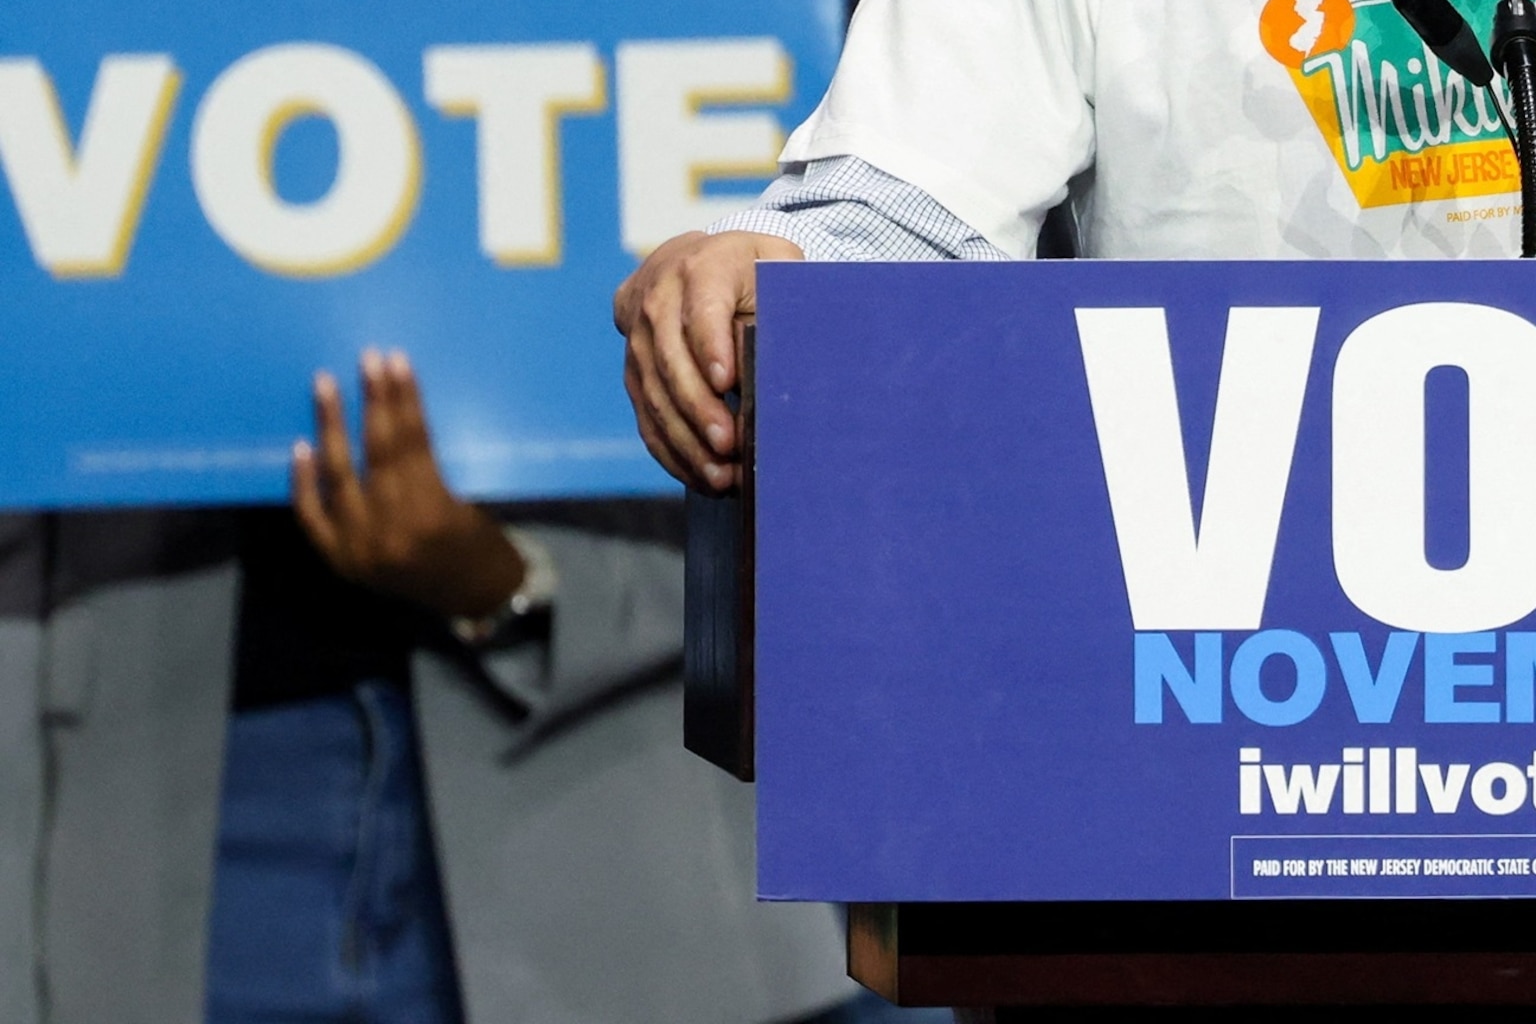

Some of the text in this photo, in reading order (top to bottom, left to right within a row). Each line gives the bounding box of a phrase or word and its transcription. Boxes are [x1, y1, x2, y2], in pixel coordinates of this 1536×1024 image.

[0, 36, 793, 280] VOTE
[1389, 155, 1442, 191] NEW
[1447, 148, 1516, 186] JERSE
[1446, 210, 1472, 223] PAID
[1473, 208, 1497, 221] FOR
[1498, 206, 1510, 219] BY
[1252, 859, 1281, 876] PAID
[1282, 859, 1306, 876] FOR
[1307, 859, 1325, 876] BY
[1325, 859, 1349, 876] THE
[1349, 859, 1378, 876] NEW
[1379, 858, 1422, 876] JERSEY
[1423, 858, 1495, 875] DEMOCRATIC
[1496, 858, 1531, 875] STATE
